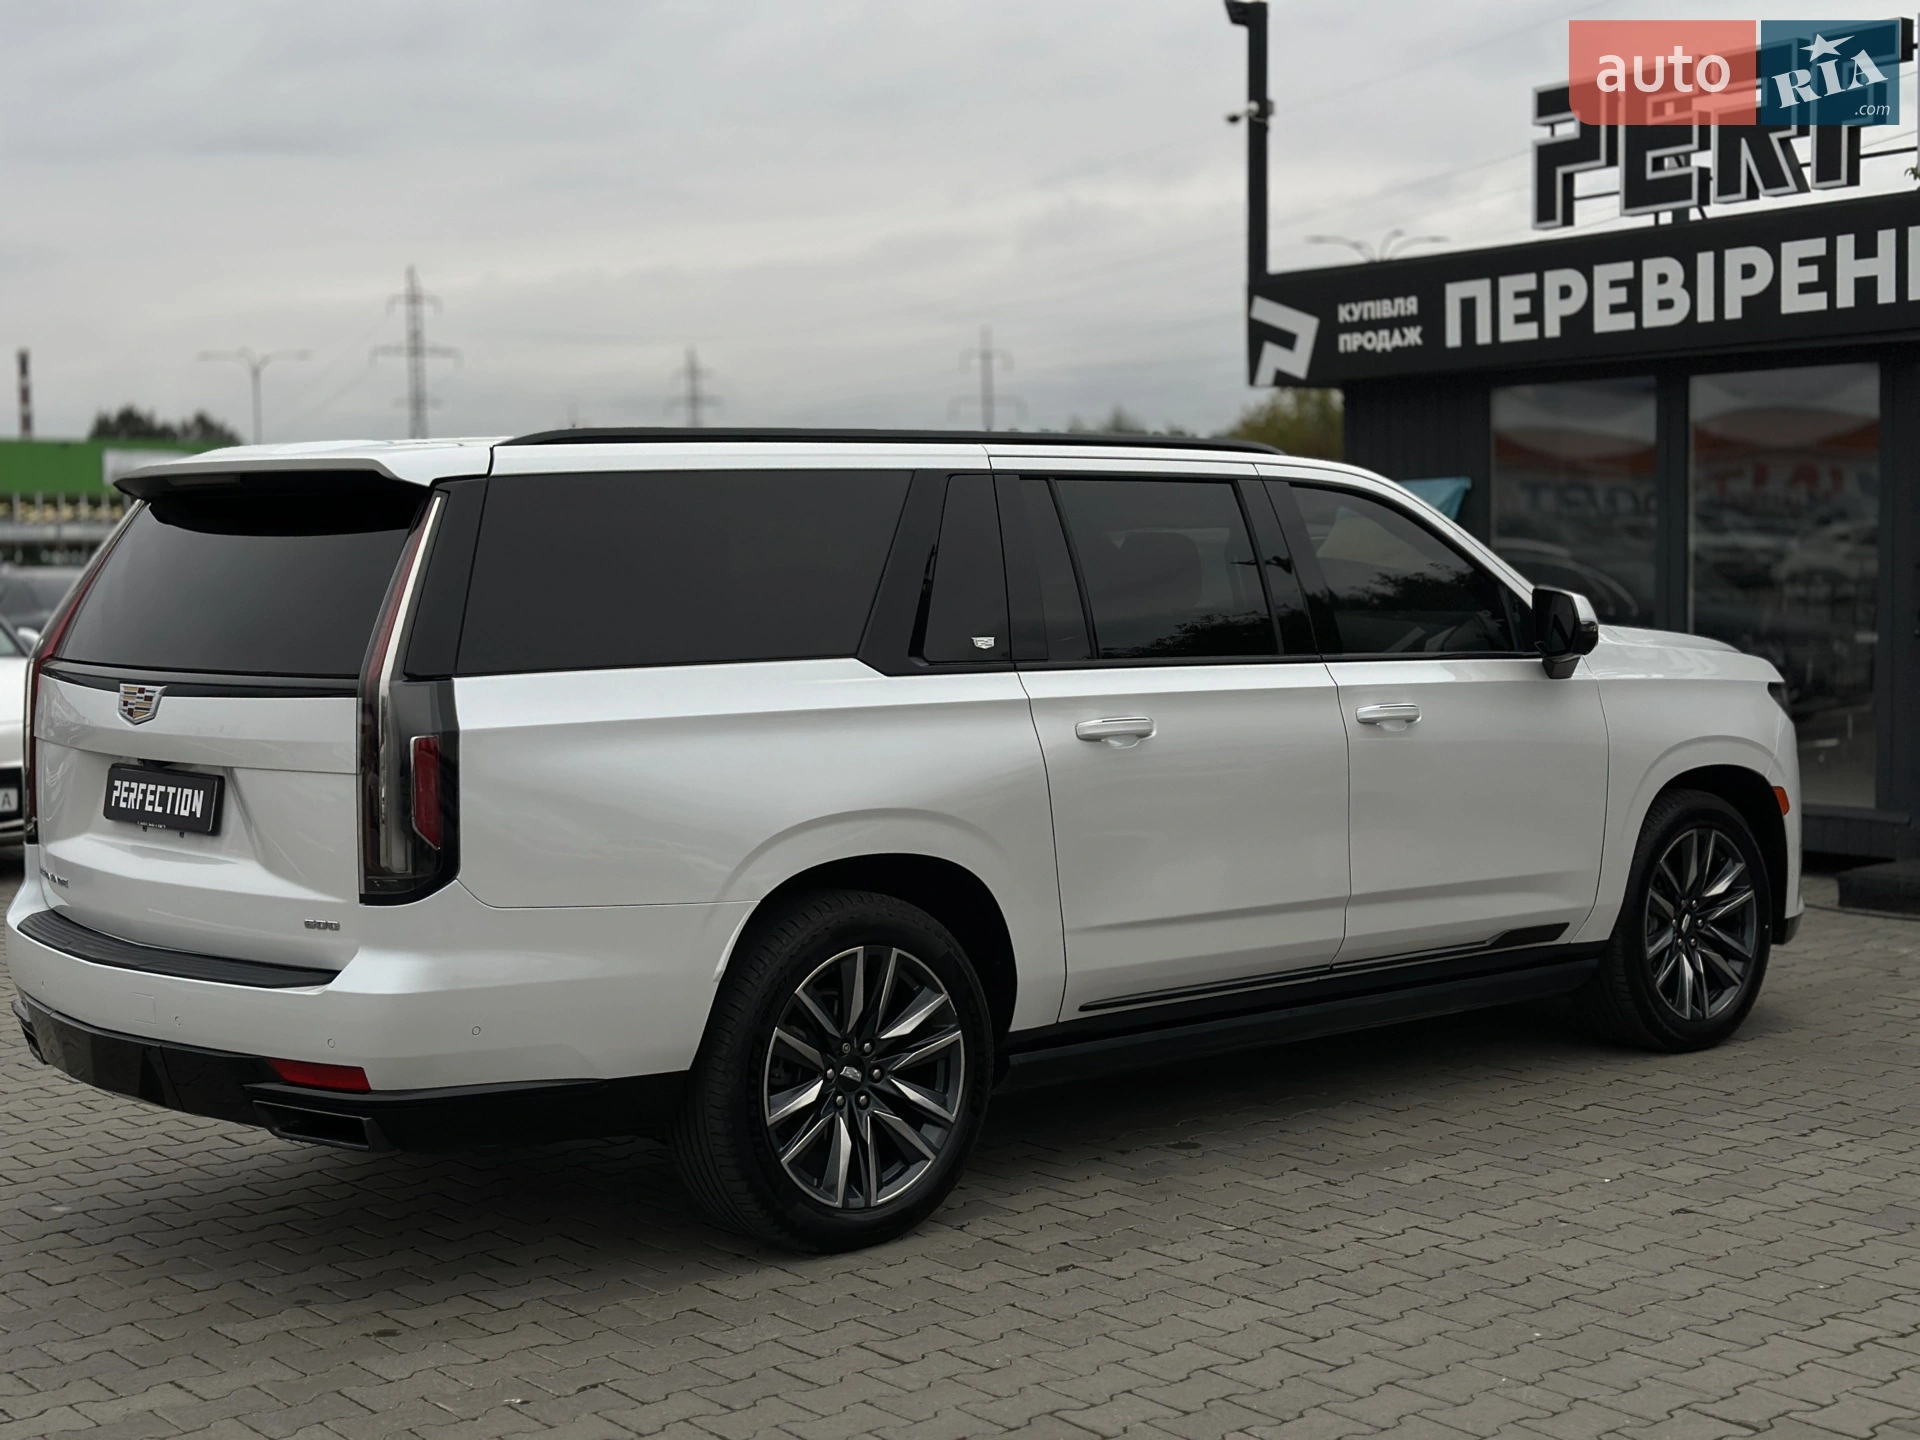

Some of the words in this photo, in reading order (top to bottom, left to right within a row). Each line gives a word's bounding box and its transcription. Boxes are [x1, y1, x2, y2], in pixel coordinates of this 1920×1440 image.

[1532, 17, 1920, 231] PERF
[1337, 295, 1418, 323] КУПІВЛЯ
[1337, 325, 1423, 353] ПРОДАЖ
[111, 779, 204, 818] PERFECTION
